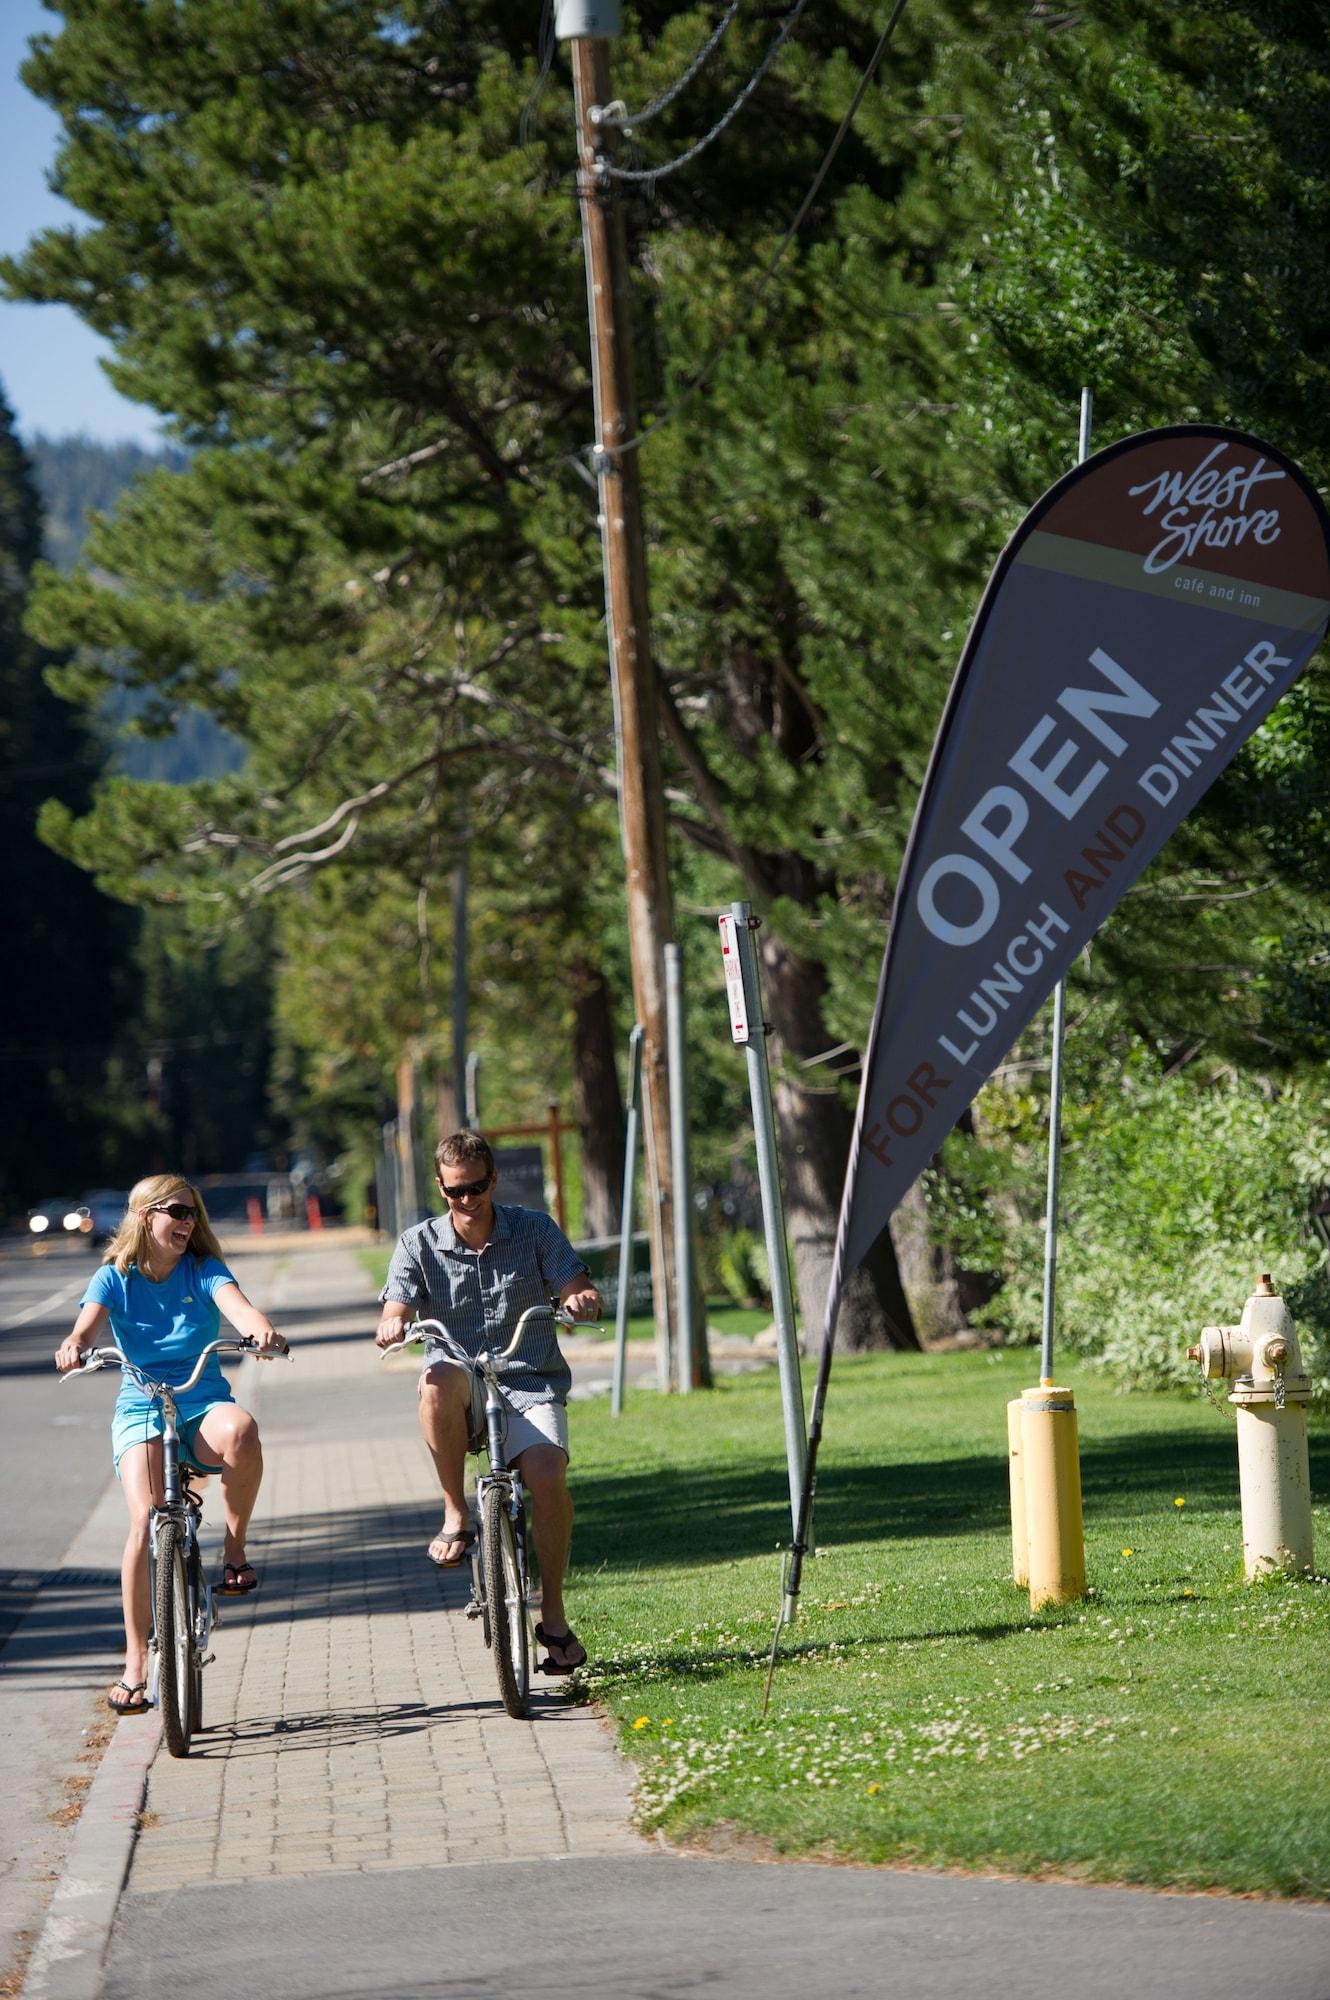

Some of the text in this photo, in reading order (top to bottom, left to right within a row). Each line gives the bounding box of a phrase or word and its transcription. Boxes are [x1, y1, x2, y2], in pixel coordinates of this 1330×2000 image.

[1128, 442, 1286, 515] West
[1143, 506, 1281, 574] Shore
[1209, 585, 1235, 600] and
[1240, 590, 1261, 607] inn
[917, 647, 1161, 946] OPEN
[863, 640, 1293, 1168] FOR LUNCH AND DINNER
